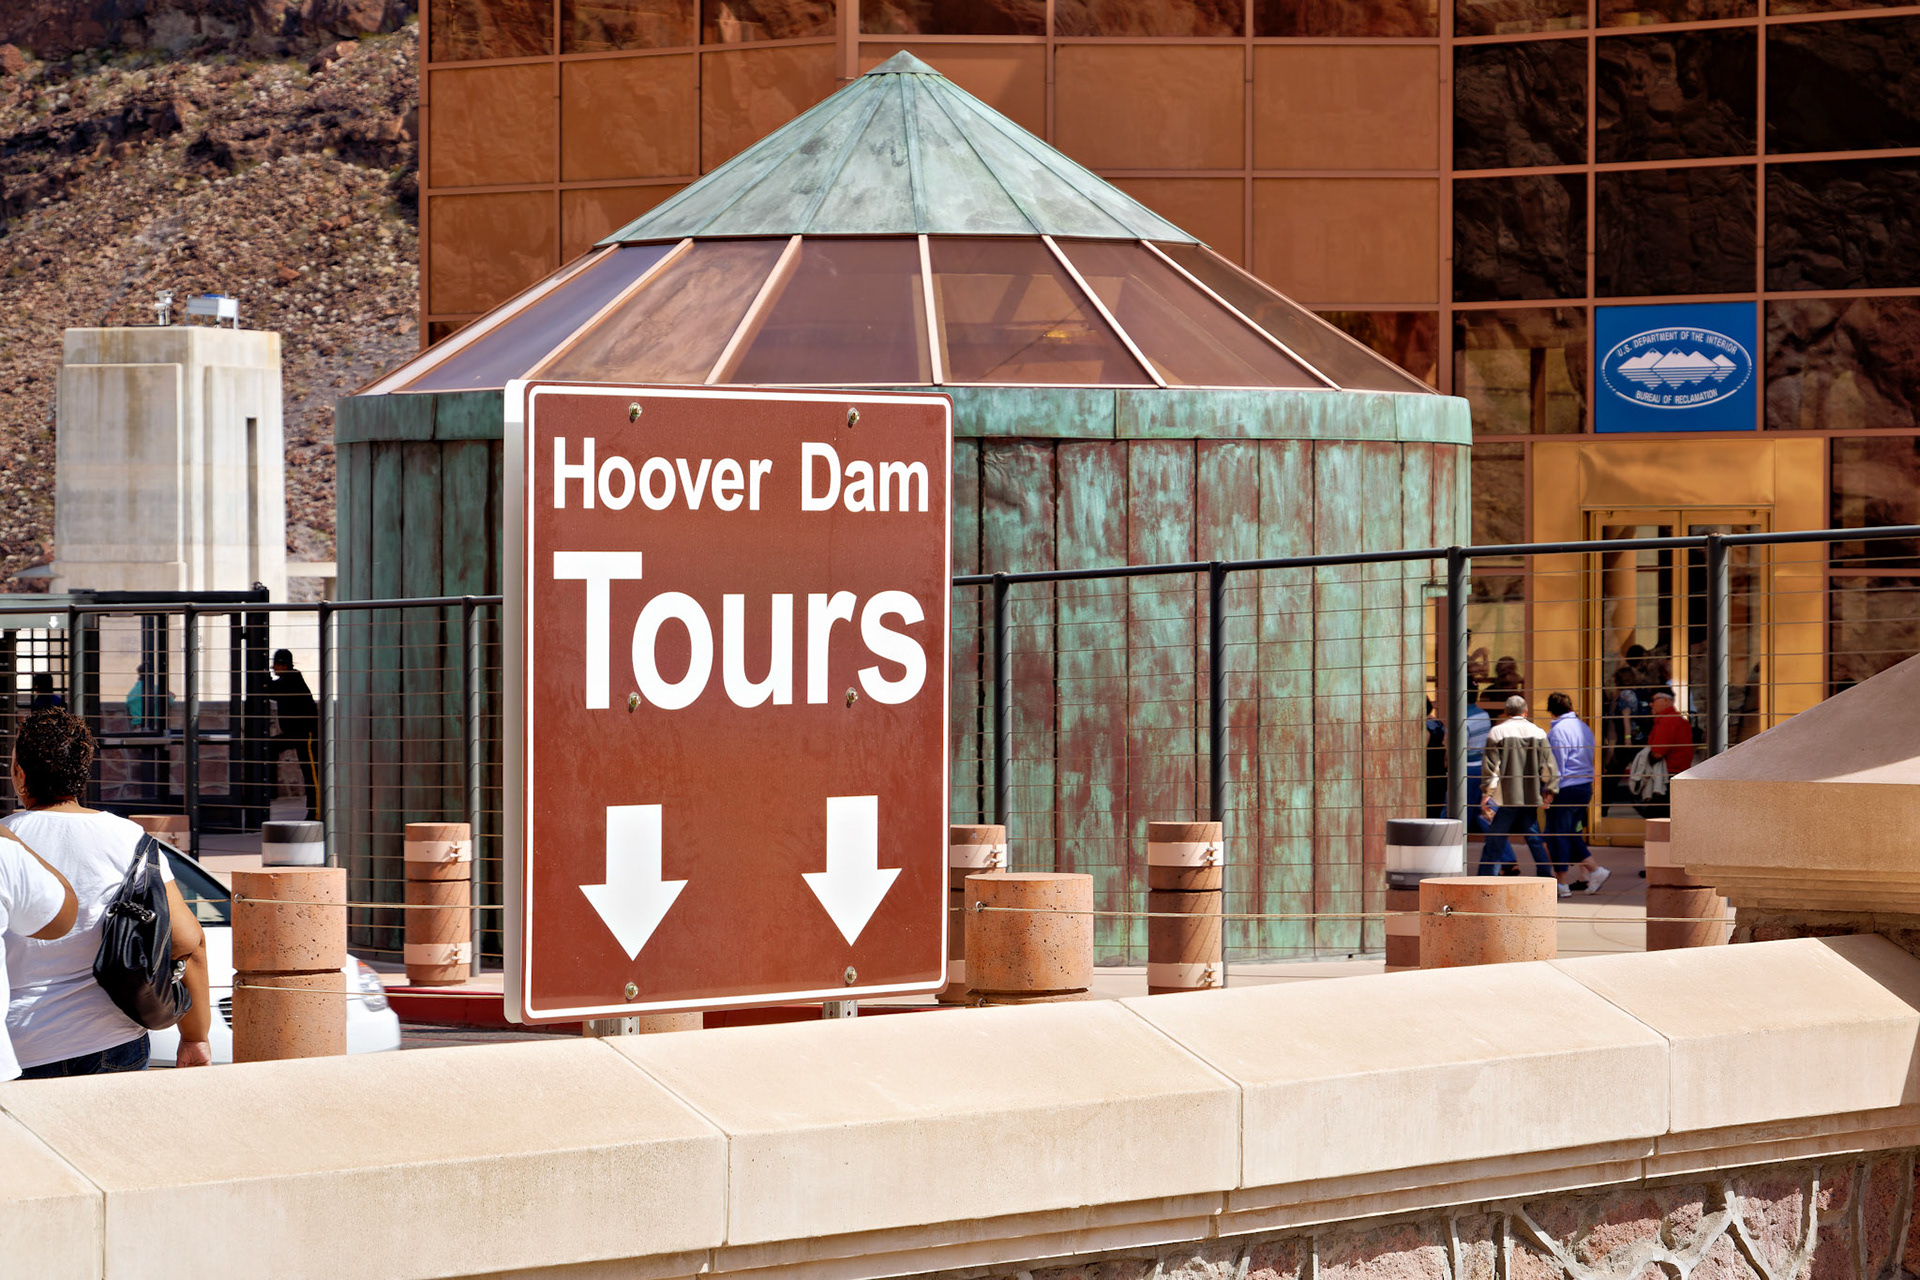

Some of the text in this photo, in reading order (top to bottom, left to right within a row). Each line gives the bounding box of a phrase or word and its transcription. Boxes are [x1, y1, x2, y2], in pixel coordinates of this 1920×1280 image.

[1617, 331, 1738, 357] U.S. DEPARTMENT OF THE INTERIOR
[1635, 388, 1718, 404] BUREAU OF RECLAMATION
[553, 436, 930, 513] Hoover Dam
[553, 551, 927, 710] Tours
